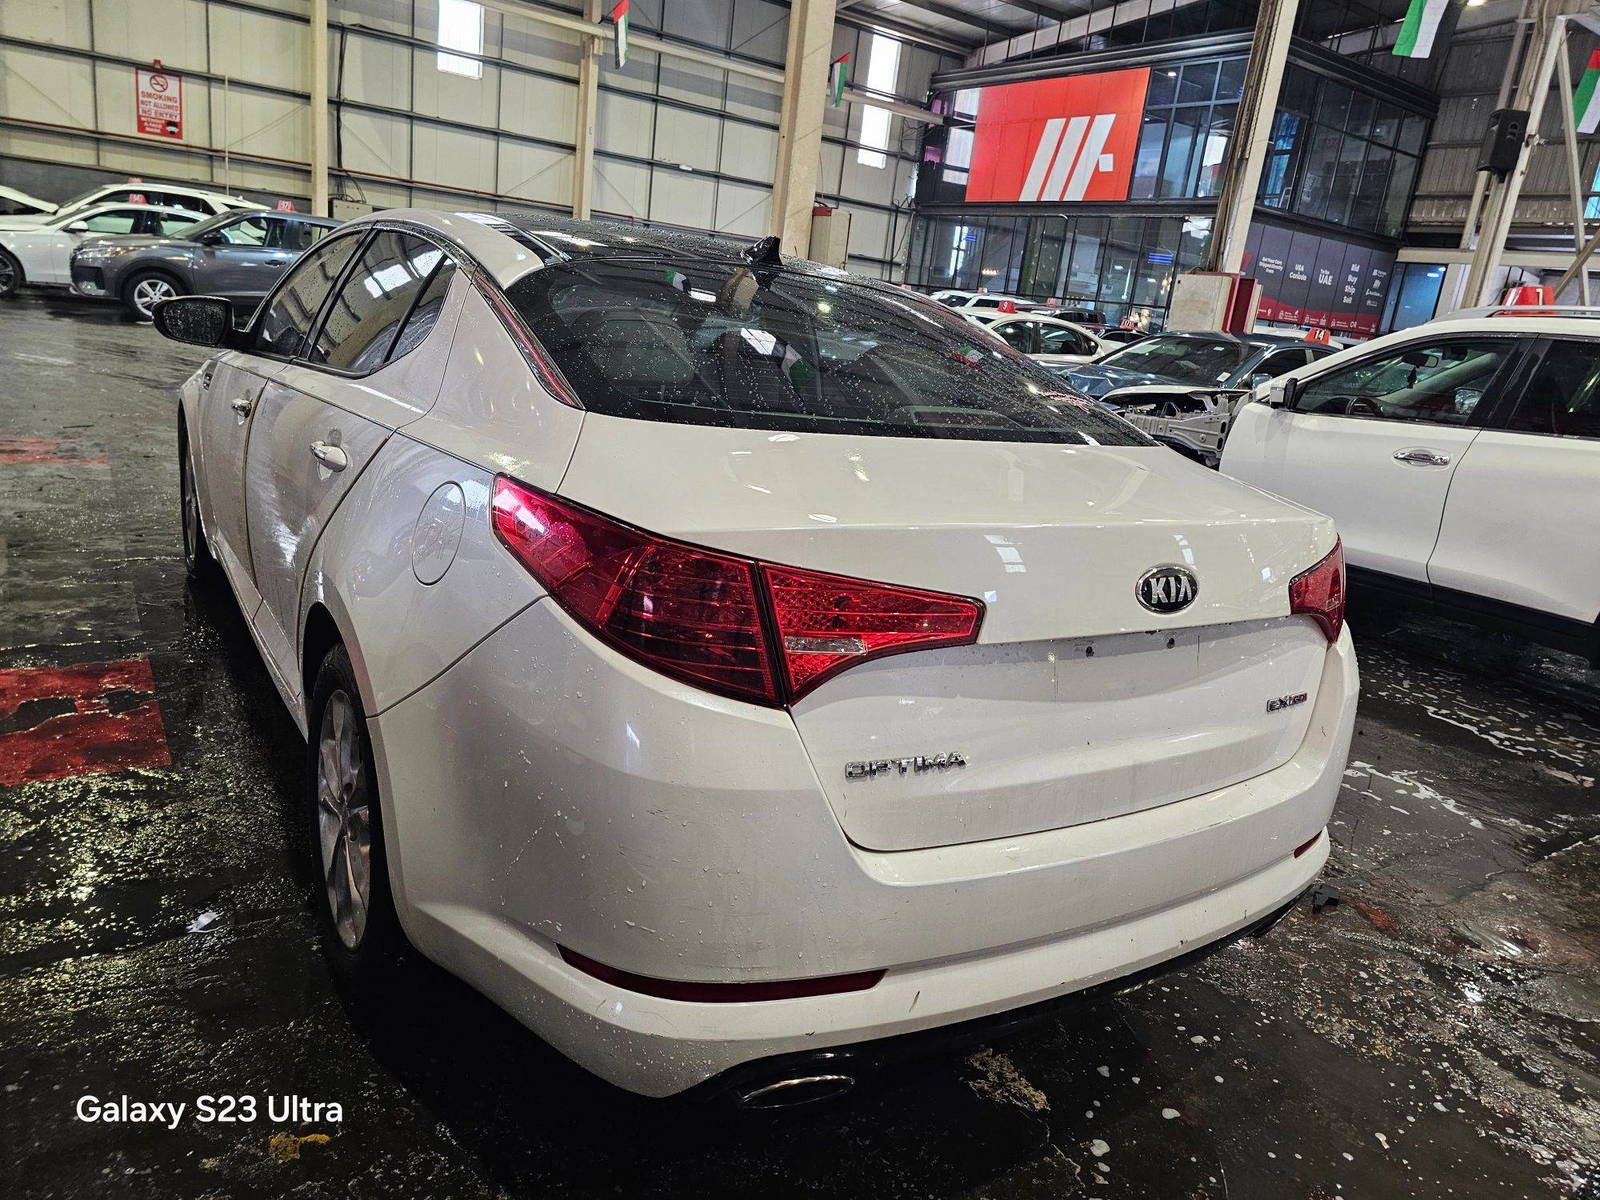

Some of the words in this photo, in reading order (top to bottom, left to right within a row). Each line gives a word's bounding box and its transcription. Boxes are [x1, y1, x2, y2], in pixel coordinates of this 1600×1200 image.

[141, 91, 177, 103] SMOKING
[153, 102, 178, 112] ALLOWED
[154, 111, 178, 120] ENTRY
[1289, 272, 1307, 281] Canada
[1318, 273, 1333, 286] UAE
[1347, 274, 1359, 286] Buy
[1344, 285, 1356, 296] Ship
[1343, 296, 1353, 304] Sell
[1314, 329, 1325, 341] 14
[1150, 576, 1193, 604] KIA
[1268, 695, 1289, 712] EX
[845, 751, 967, 778] OPTIMA
